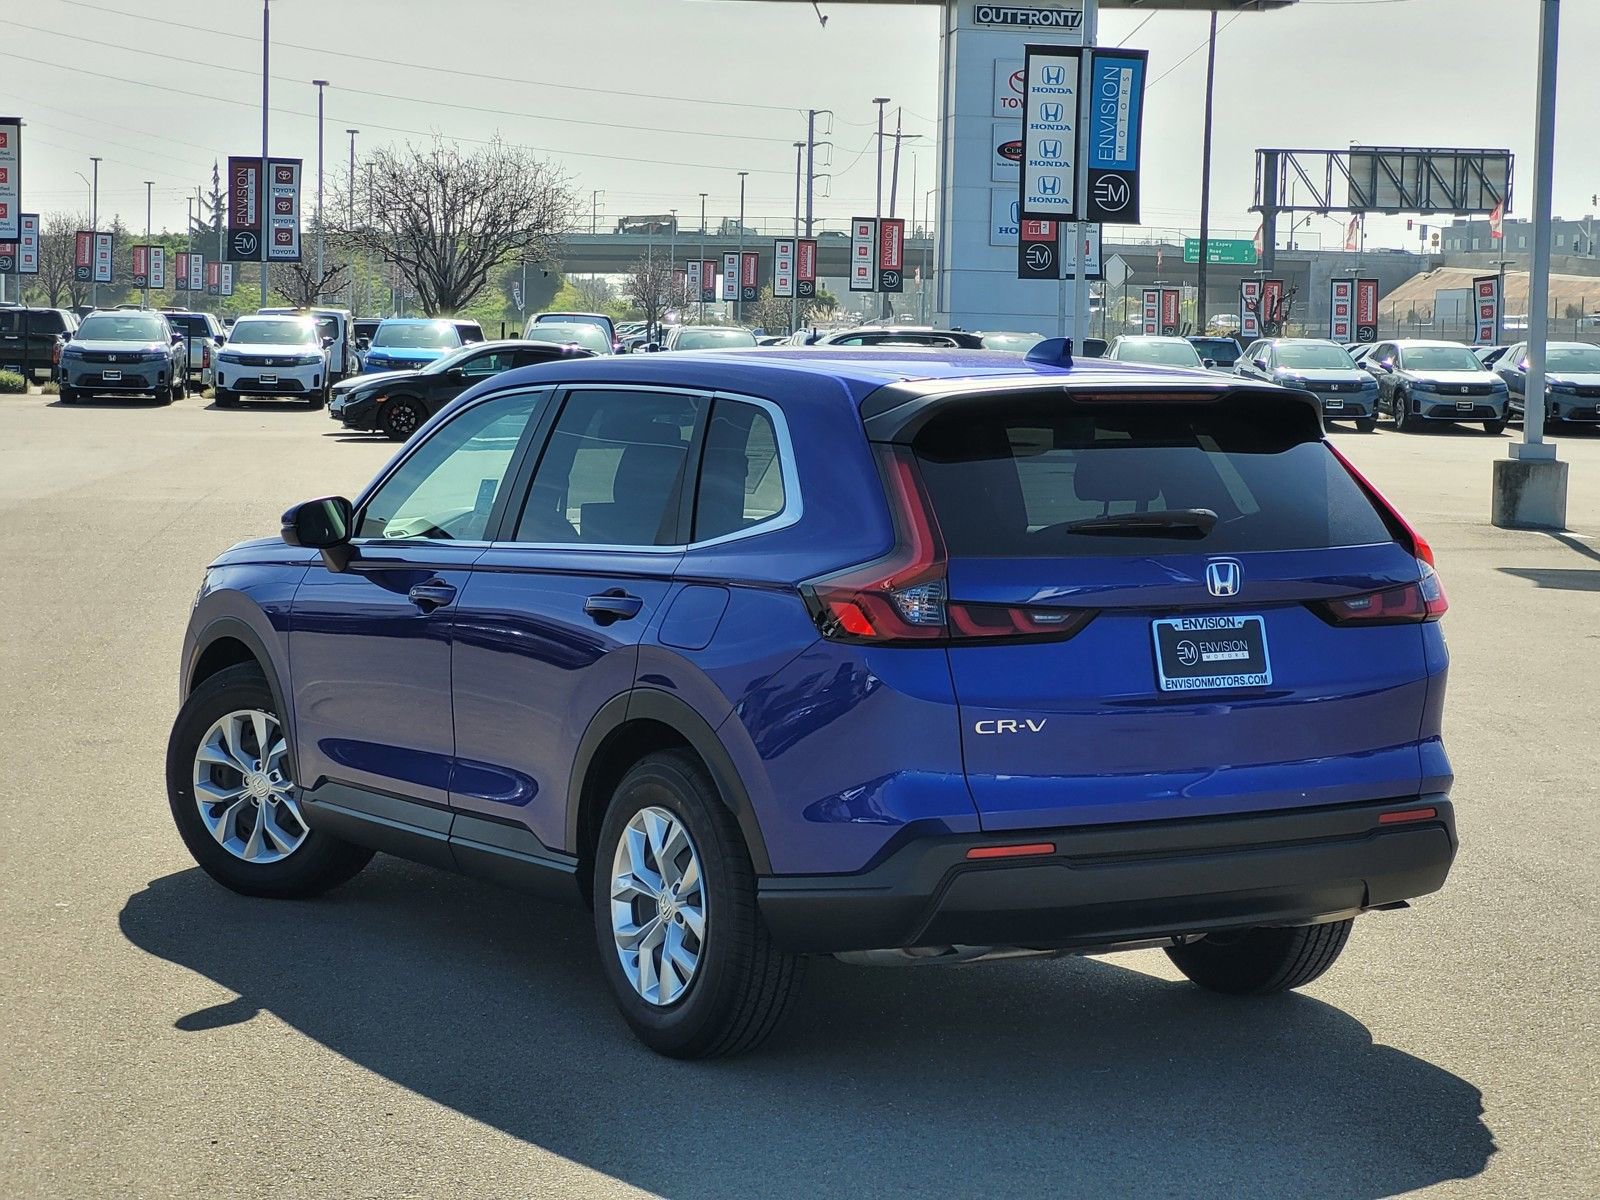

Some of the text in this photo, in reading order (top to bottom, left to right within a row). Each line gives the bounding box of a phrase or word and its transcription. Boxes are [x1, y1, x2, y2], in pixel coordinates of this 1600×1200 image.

[1099, 66, 1119, 160] ENVISION
[1118, 76, 1130, 153] MOTORS
[1029, 160, 1071, 168] HONDA
[236, 168, 248, 224] ENVISION
[884, 225, 893, 266] ENVISION
[1182, 617, 1235, 630] ENVISION
[1200, 640, 1248, 653] ENVISION
[1206, 652, 1245, 660] MOTORS
[1165, 674, 1268, 690] ENVISIONMOTORS.COM
[975, 718, 1047, 734] CR-V
